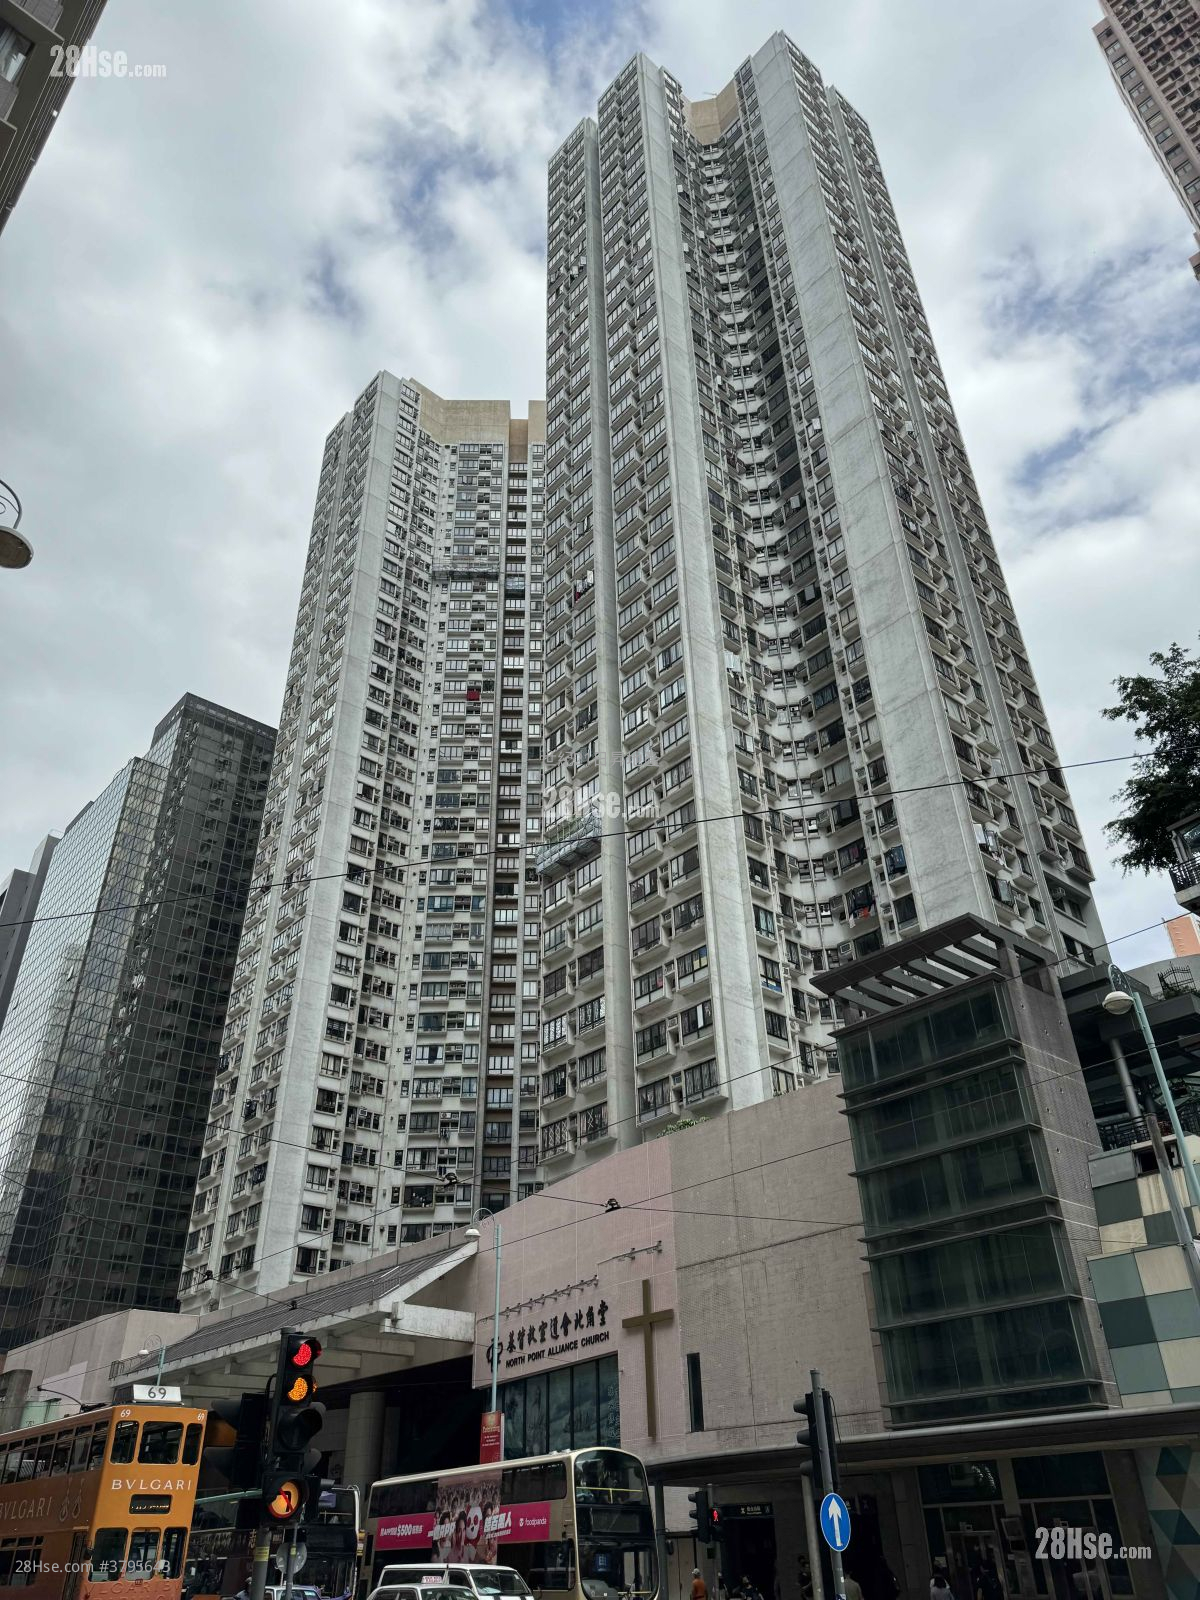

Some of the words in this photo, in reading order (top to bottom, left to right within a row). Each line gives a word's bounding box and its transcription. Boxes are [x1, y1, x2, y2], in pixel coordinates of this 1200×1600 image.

[506, 1300, 608, 1353] 基督教宣道會北角堂
[505, 1355, 525, 1368] NORTH
[527, 1350, 546, 1363] POINT
[547, 1340, 578, 1357] ALLIANCE
[581, 1331, 610, 1347] CHURCH
[147, 1386, 167, 1400] 69
[120, 1409, 131, 1418] 69
[197, 1412, 205, 1421] 69
[111, 1479, 192, 1491] BVLGARI
[524, 1517, 547, 1528] foodpanda
